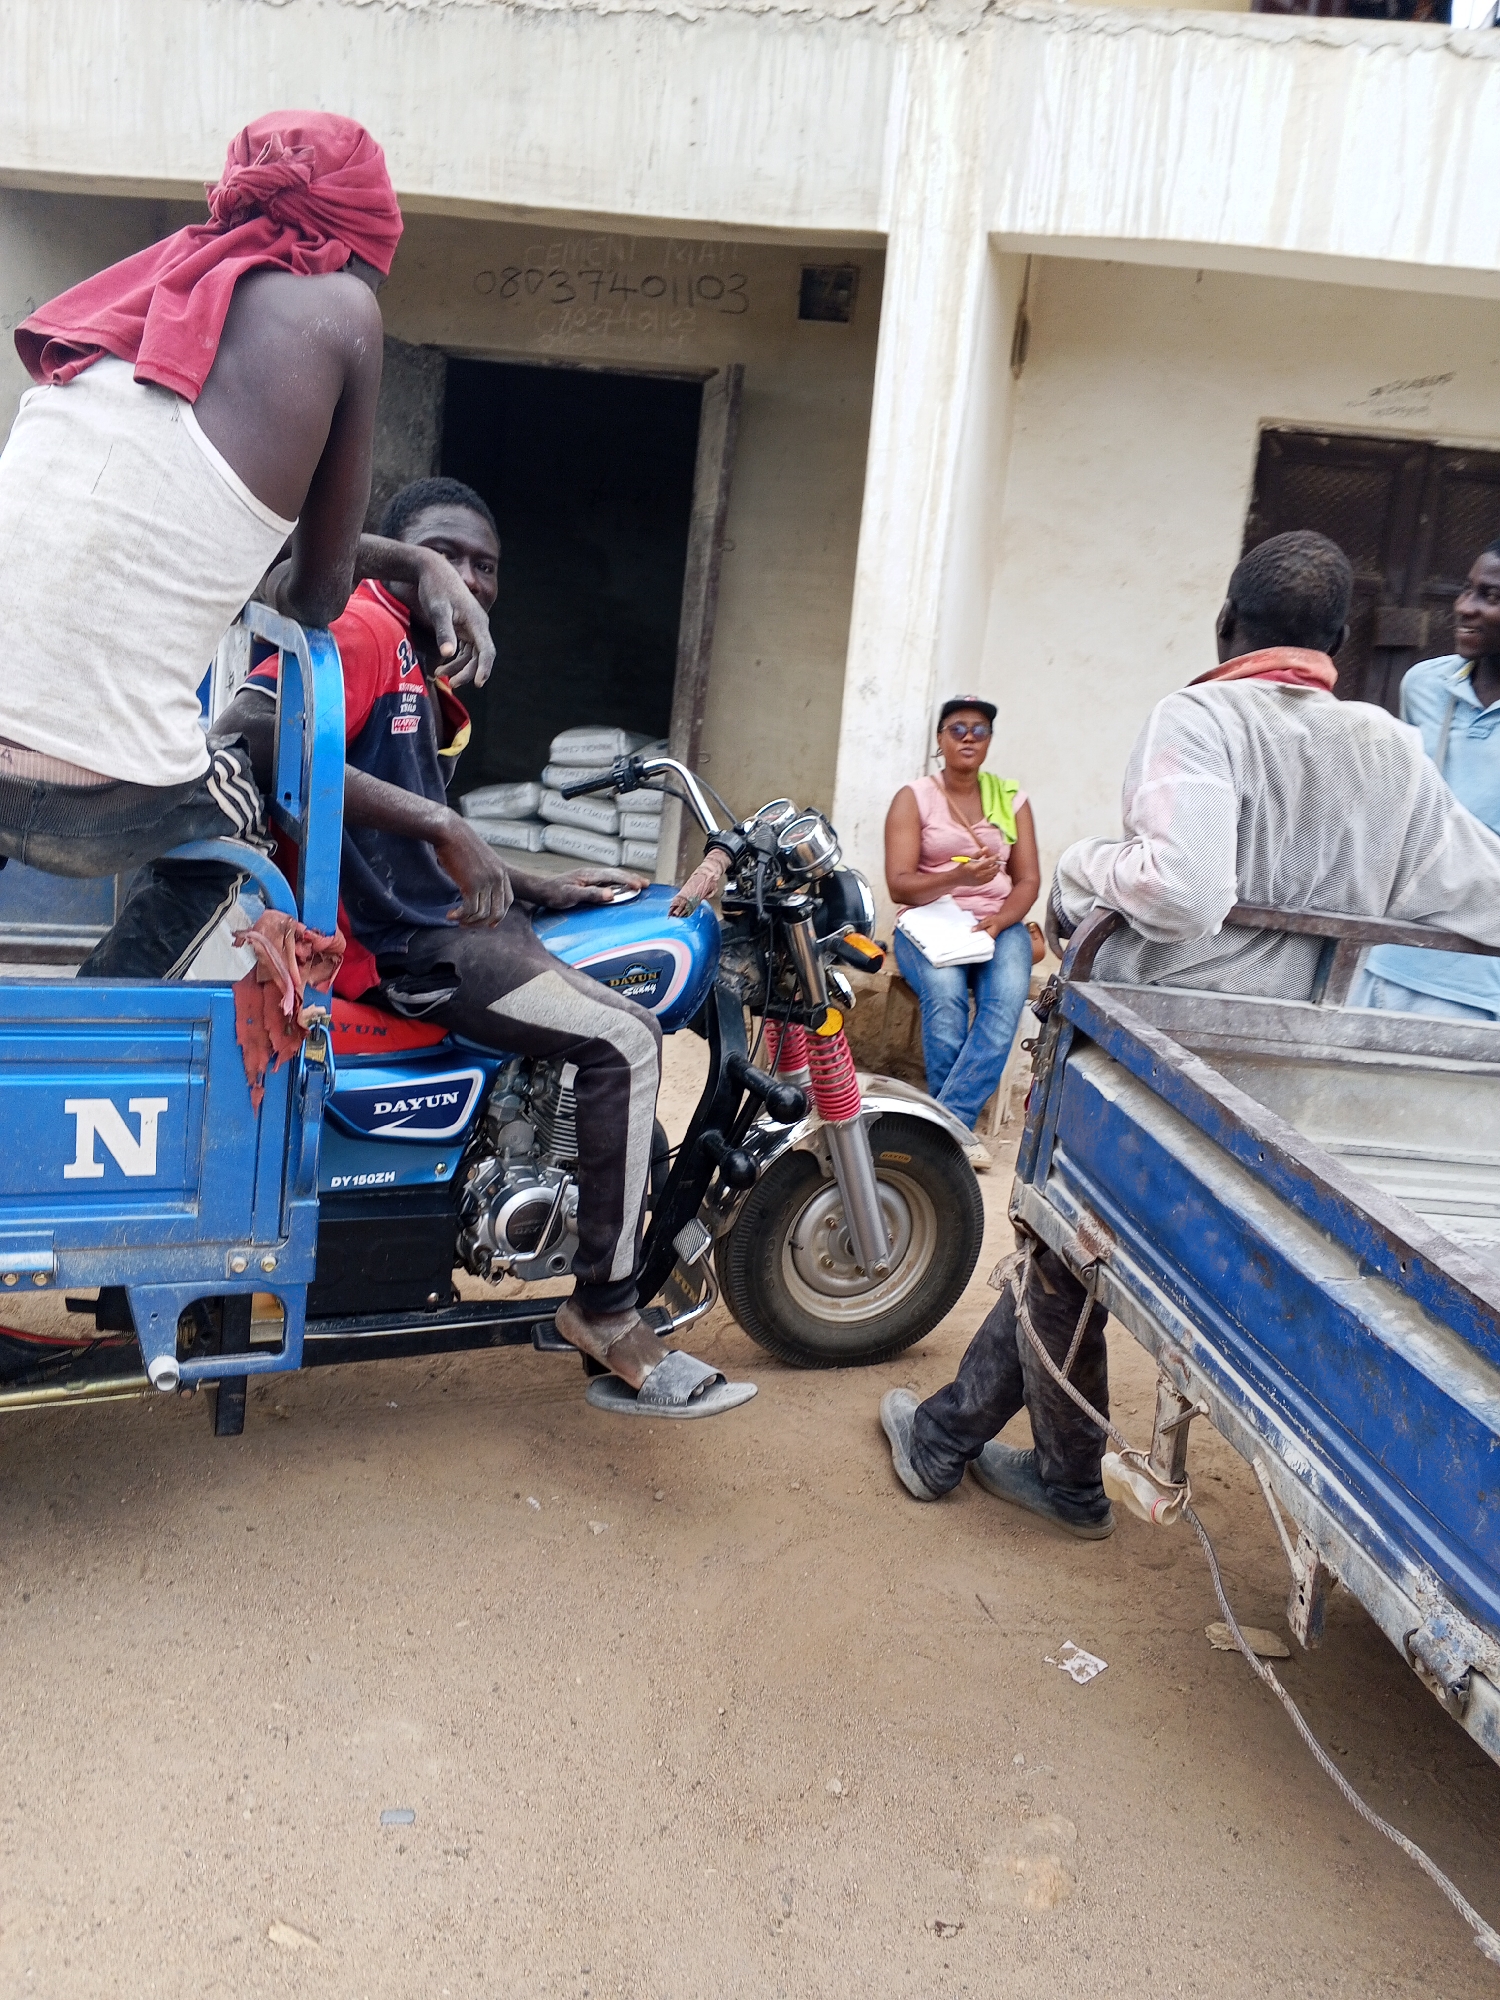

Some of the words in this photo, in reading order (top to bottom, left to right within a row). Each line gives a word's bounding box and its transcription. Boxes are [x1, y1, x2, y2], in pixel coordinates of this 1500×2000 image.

[473, 267, 751, 315] 08037401103
[609, 972, 657, 987] DAYUN
[621, 982, 657, 997] Sunny
[328, 1021, 388, 1036] AYUN
[373, 1091, 459, 1116] DAYUN
[63, 1097, 169, 1179] N
[330, 1170, 396, 1188] DY150ZH
